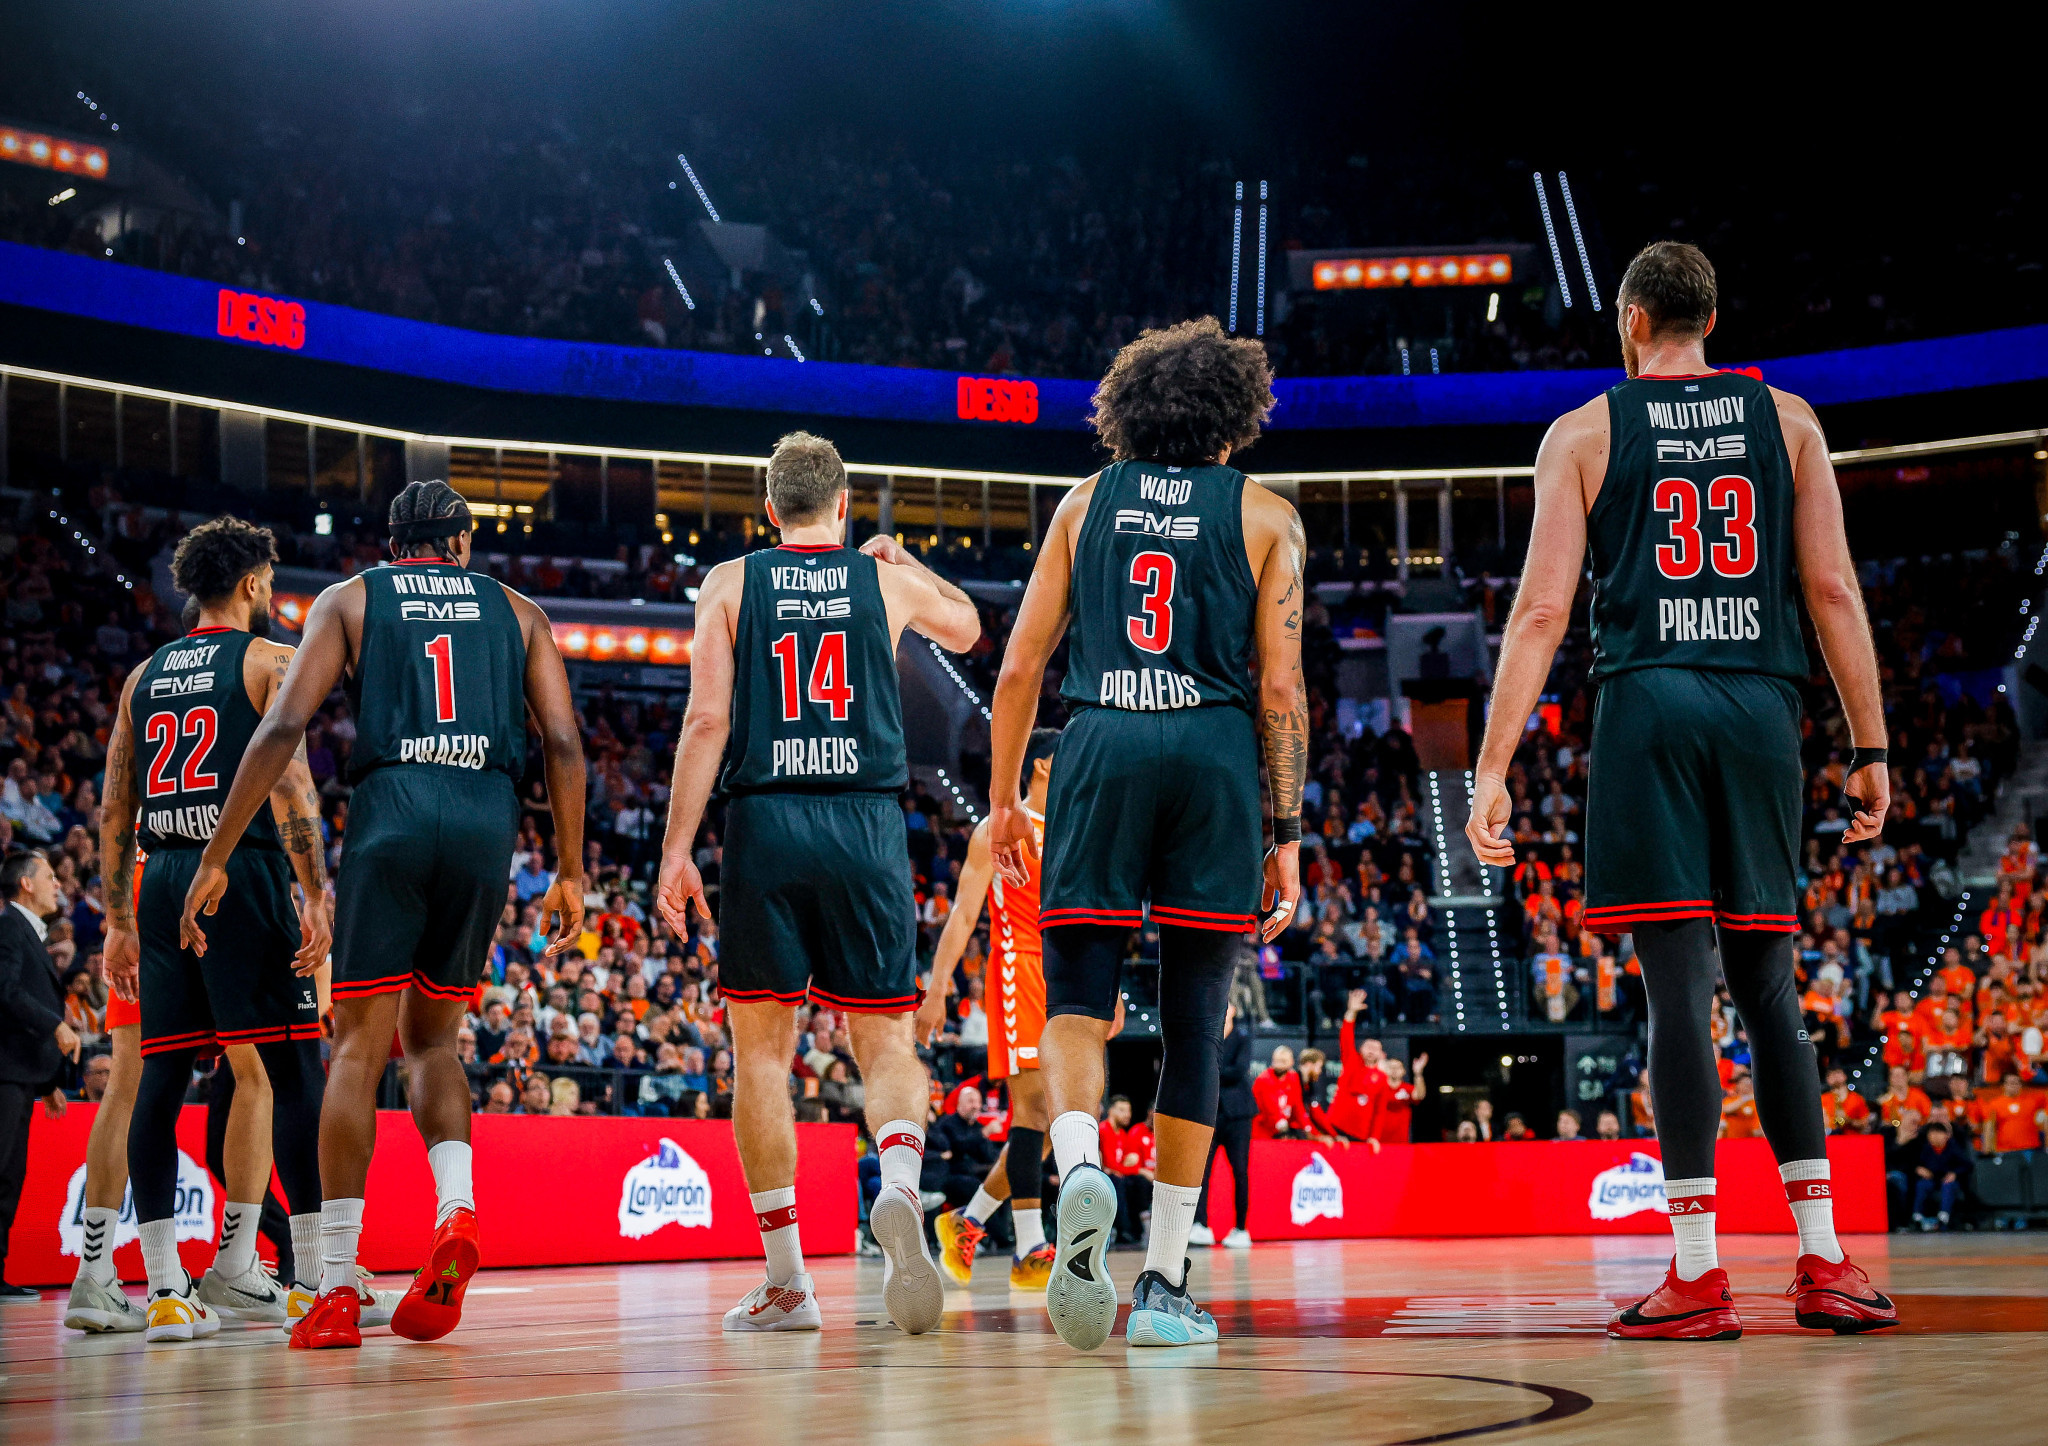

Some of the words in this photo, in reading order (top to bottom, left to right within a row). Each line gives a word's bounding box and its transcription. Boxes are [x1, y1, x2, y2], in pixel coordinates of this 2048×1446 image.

[217, 288, 306, 350] DESIG
[957, 376, 1039, 424] DESIG
[1646, 396, 1745, 430] MILUTINOV
[1656, 434, 1747, 463] FMS
[1140, 473, 1193, 506] WARD
[1114, 509, 1200, 541] FMS
[1653, 474, 1759, 580] 33
[392, 574, 477, 596] NTILIKINA
[770, 566, 848, 593] VEZENKOV
[401, 600, 481, 621] FMS
[776, 597, 851, 621] FMS
[1126, 550, 1177, 655] 3
[1659, 596, 1761, 642] PIRAEUS
[162, 644, 221, 672] DORSEY
[771, 630, 854, 722] 14
[150, 671, 215, 699] FMS
[424, 633, 457, 724] 1
[1099, 667, 1201, 711] PIRAEUS
[145, 705, 219, 799] 22
[400, 733, 490, 771] PIRAEUS
[772, 737, 859, 777] PIRAEUS
[627, 1179, 705, 1216] Lanjarón
